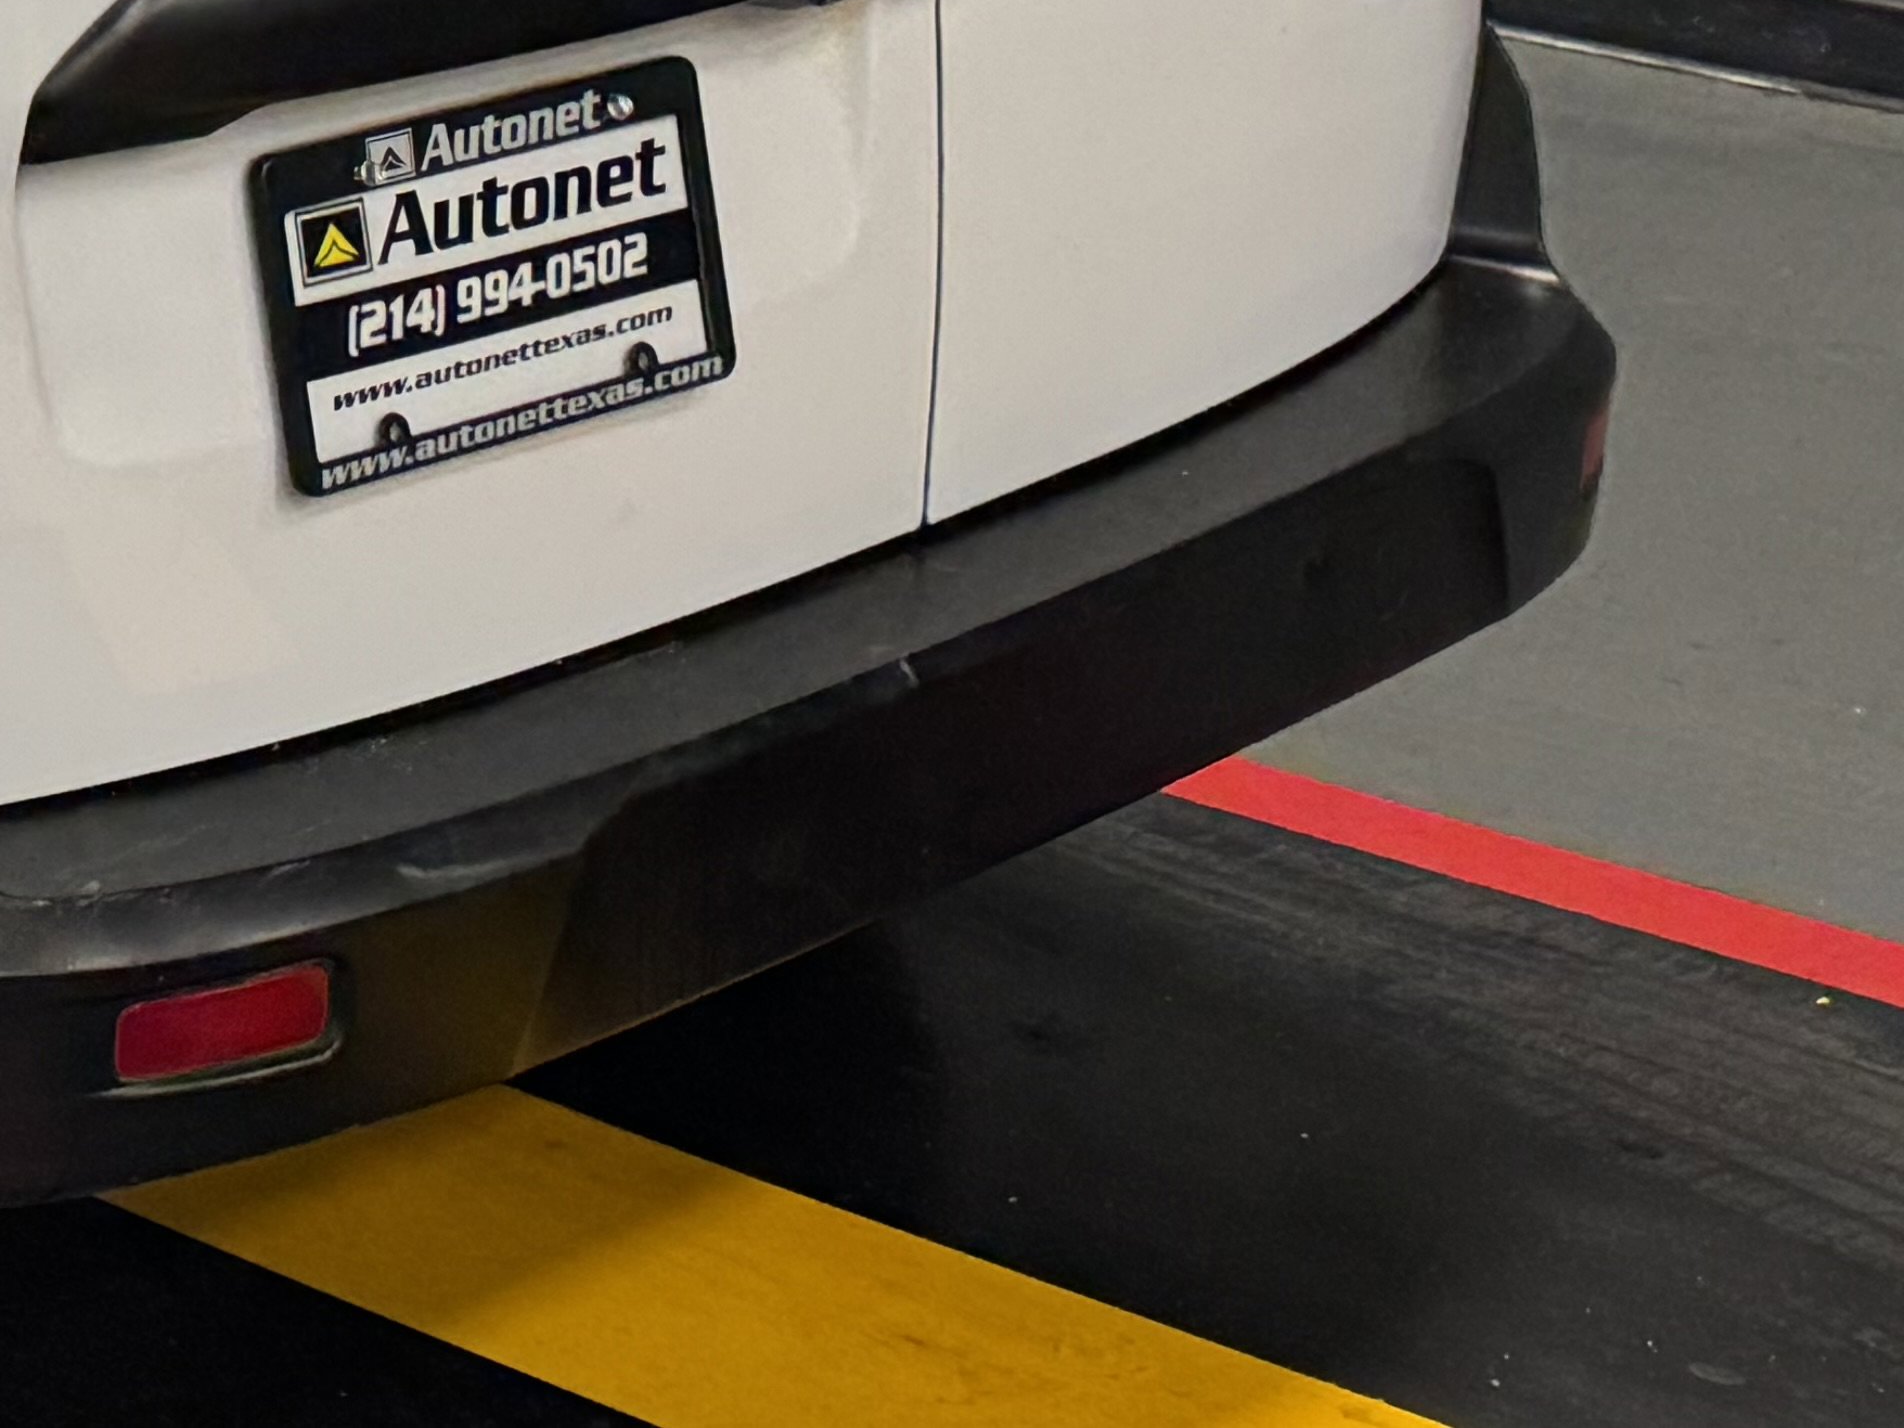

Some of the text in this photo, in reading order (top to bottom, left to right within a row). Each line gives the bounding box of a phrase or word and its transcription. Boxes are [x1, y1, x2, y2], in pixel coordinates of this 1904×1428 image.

[419, 89, 601, 173] Autonet
[378, 137, 667, 266] Autonet
[333, 303, 673, 410] www.autonettexas.com
[348, 232, 648, 357] (214) 994-0502
[321, 354, 723, 490] www.autonettexas.com
